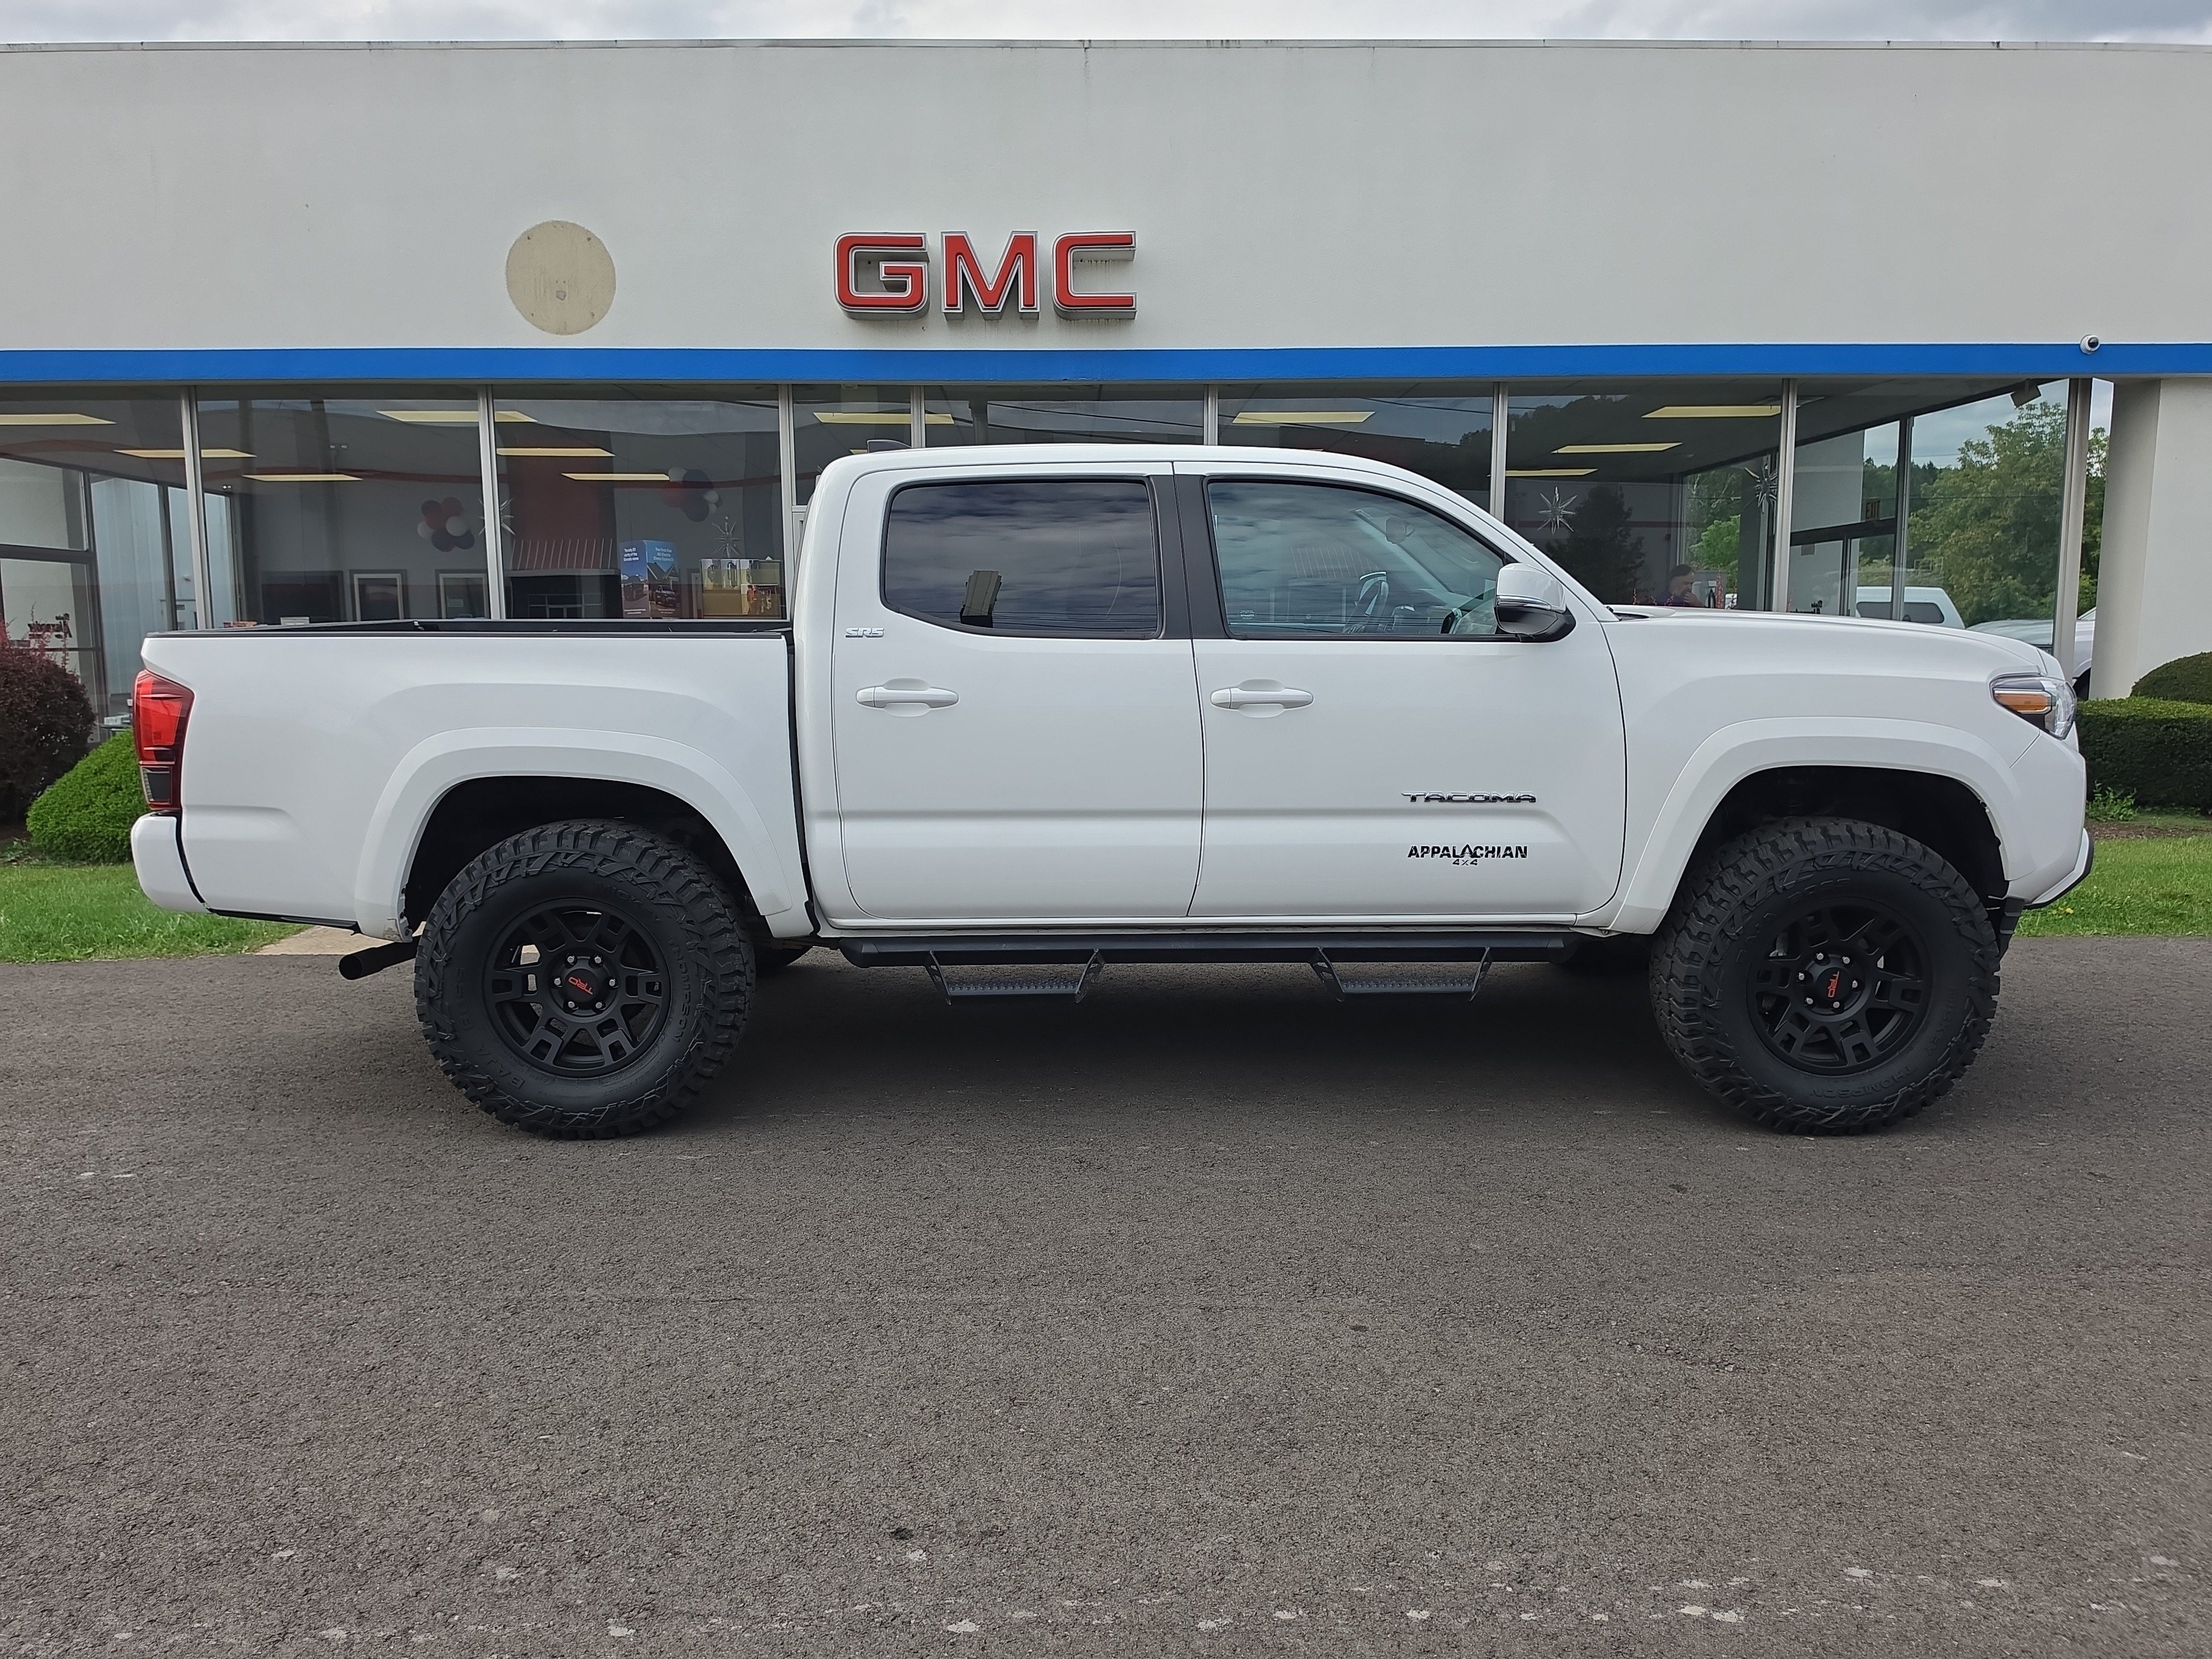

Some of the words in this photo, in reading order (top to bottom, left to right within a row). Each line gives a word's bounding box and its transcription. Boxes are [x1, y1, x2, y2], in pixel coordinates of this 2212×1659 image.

[834, 230, 1136, 320] GMC
[1866, 500, 1880, 519] EXIT
[845, 628, 884, 638] SR5
[1401, 792, 1536, 802] TACOMA
[1407, 844, 1527, 858] APPALACHIAN
